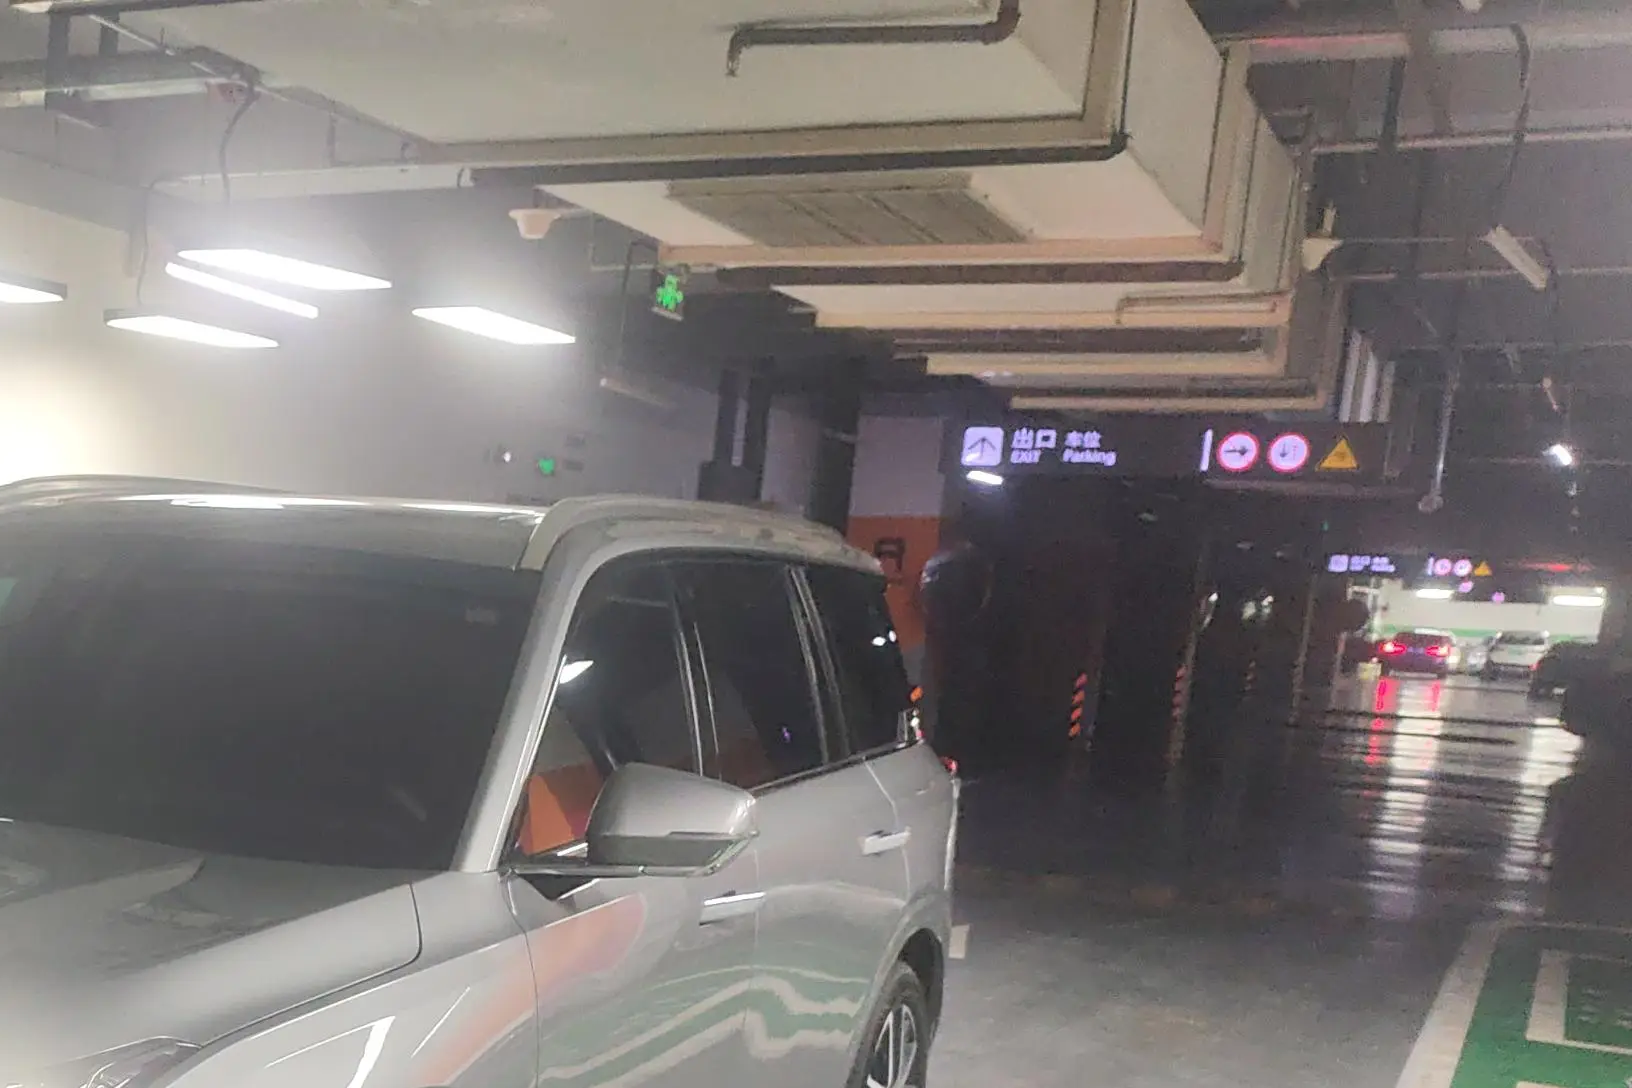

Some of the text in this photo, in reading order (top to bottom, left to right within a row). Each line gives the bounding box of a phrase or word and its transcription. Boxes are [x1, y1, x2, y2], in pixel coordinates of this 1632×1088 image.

[1011, 428, 1101, 449] 出口 车位
[1010, 449, 1117, 467] EXIT Parking
